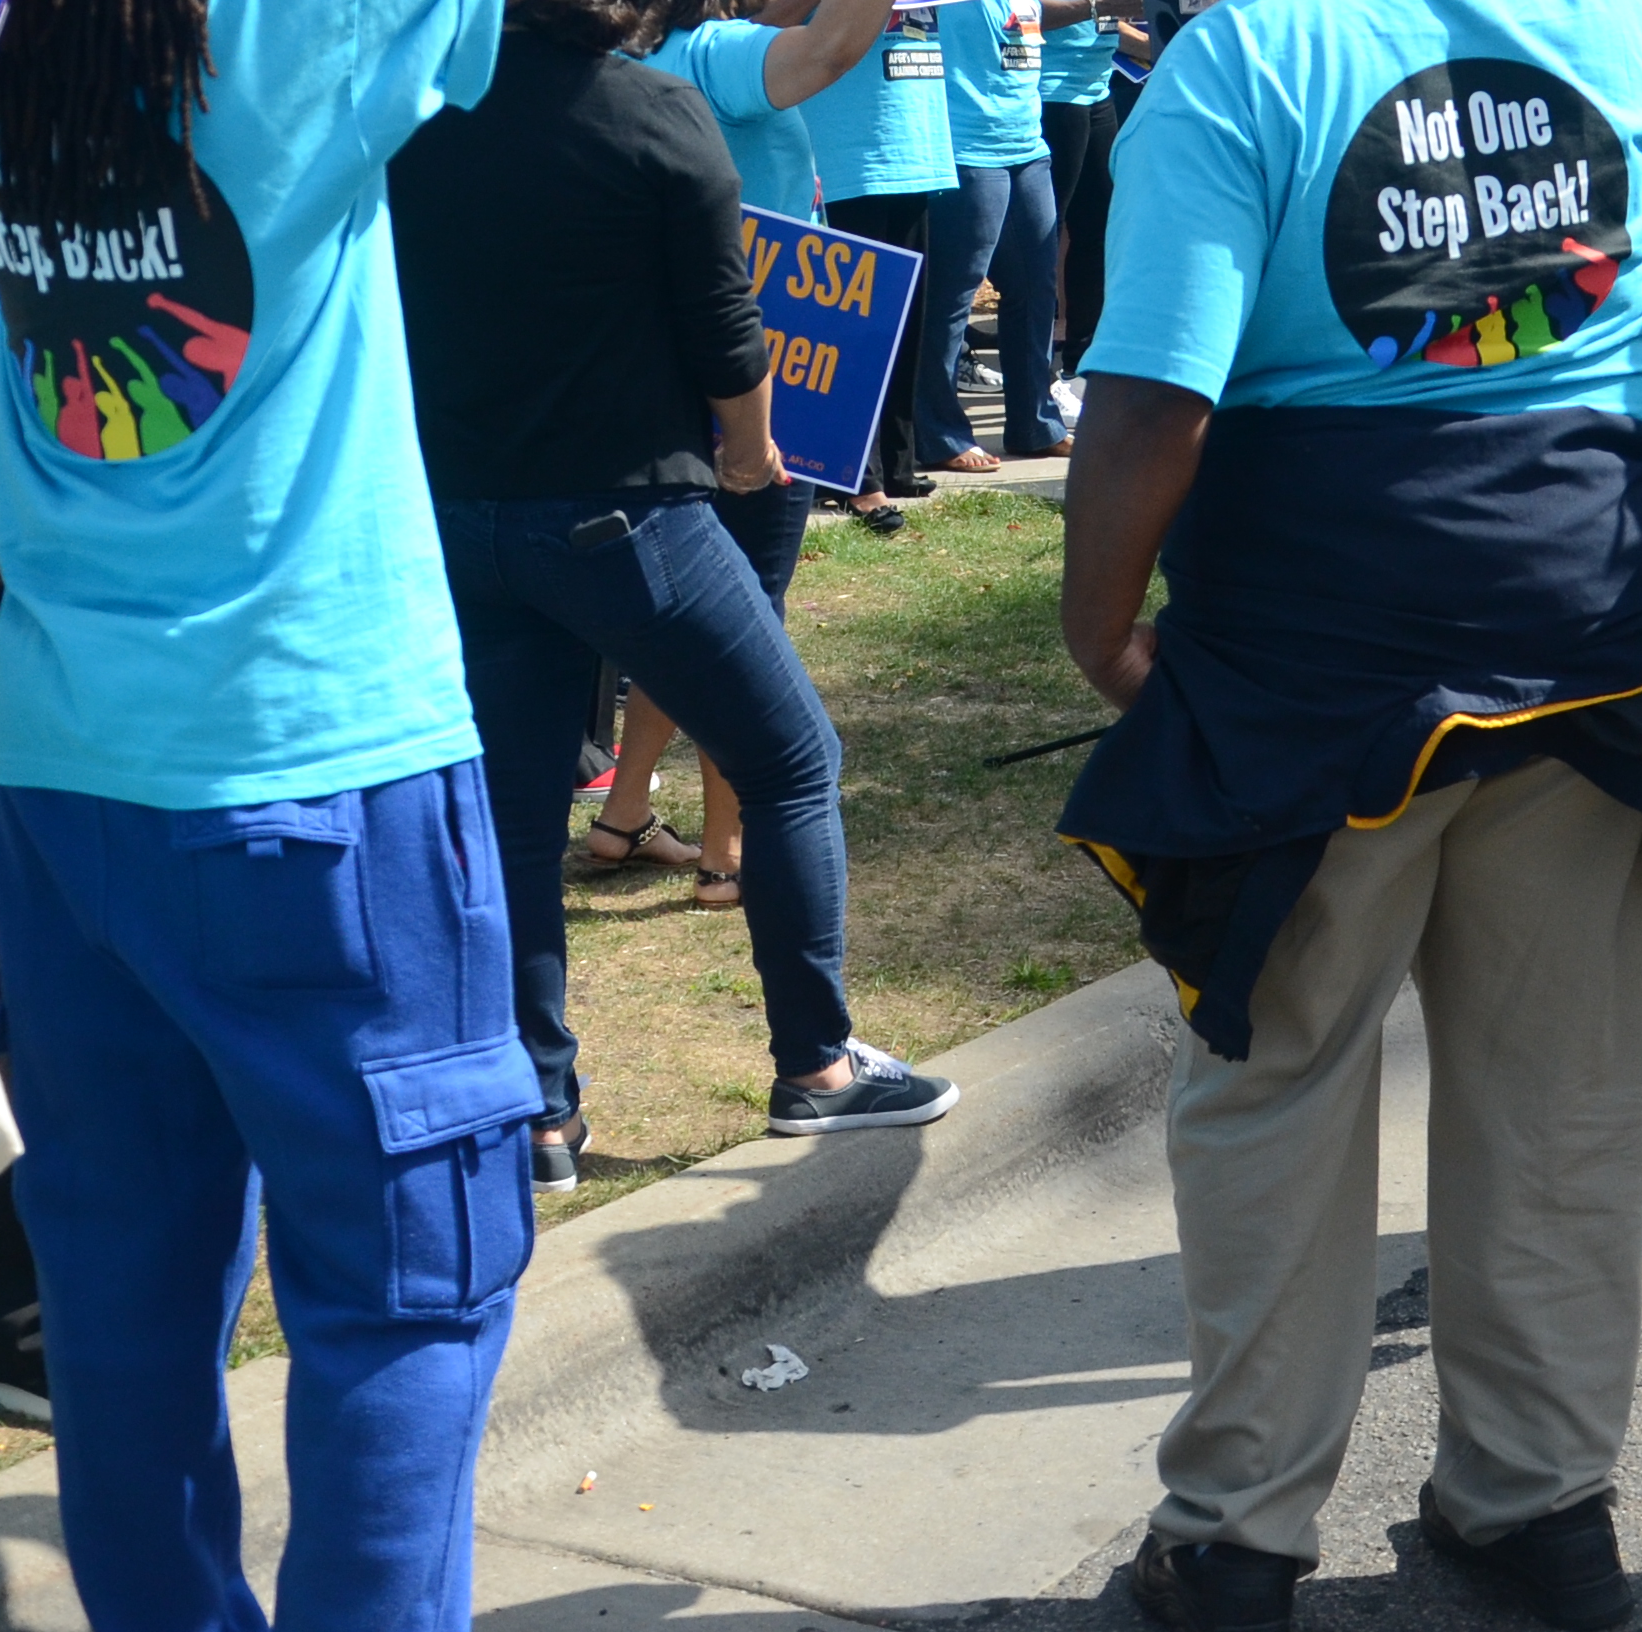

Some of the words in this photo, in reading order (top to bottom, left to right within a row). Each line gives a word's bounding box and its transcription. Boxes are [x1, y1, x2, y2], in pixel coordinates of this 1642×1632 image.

[1394, 97, 1465, 166] Not
[1467, 90, 1552, 156] One
[1376, 185, 1470, 260] Step
[1473, 159, 1590, 240] Back!
[785, 233, 877, 318] SSA
